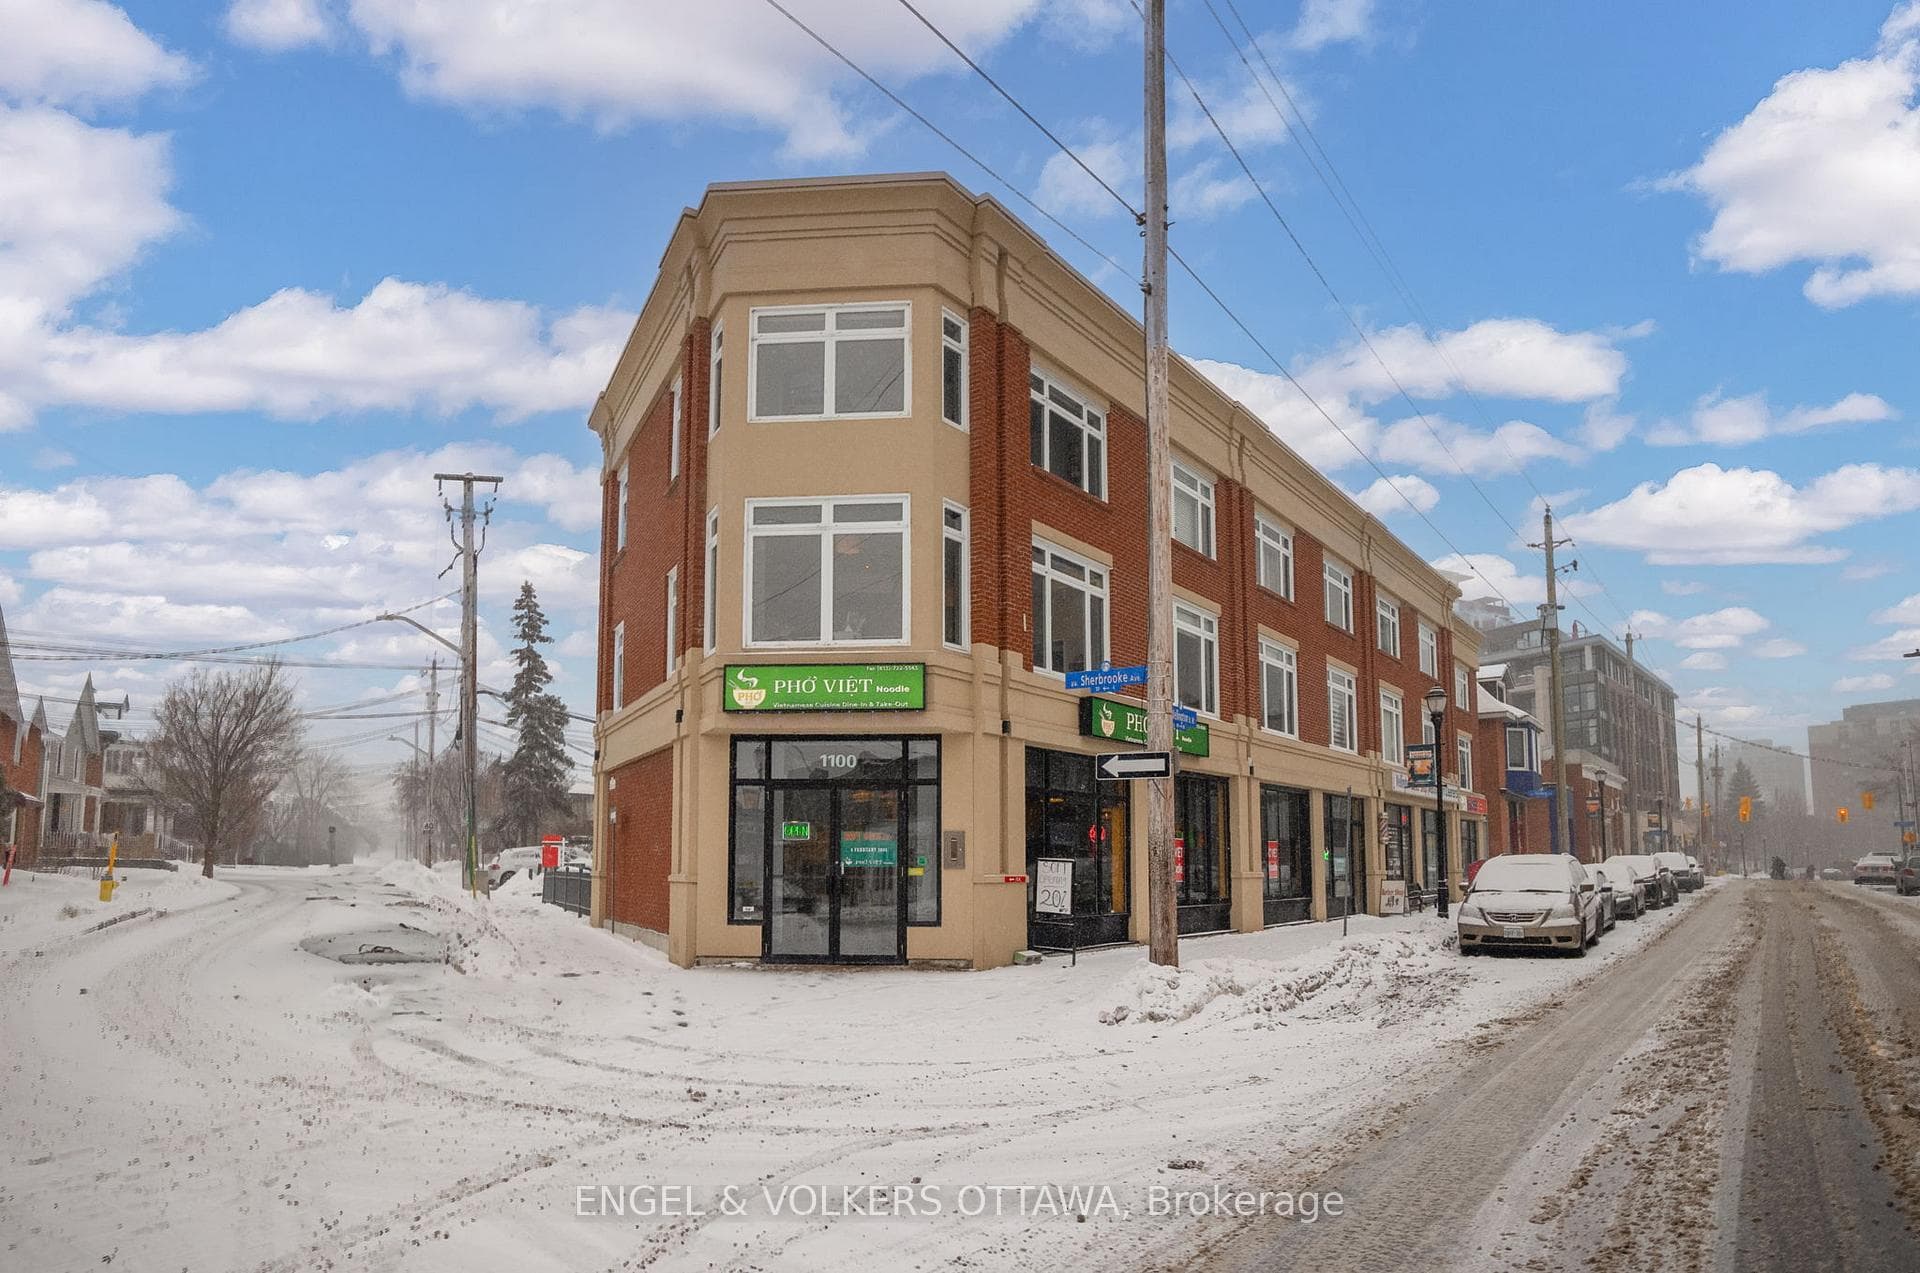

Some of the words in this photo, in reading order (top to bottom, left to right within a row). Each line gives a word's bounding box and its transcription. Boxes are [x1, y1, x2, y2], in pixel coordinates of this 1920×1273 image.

[823, 675, 873, 697] VIỆT
[876, 685, 910, 693] Noodle
[1081, 671, 1128, 686] Sherbrooke
[820, 754, 857, 768] 1100
